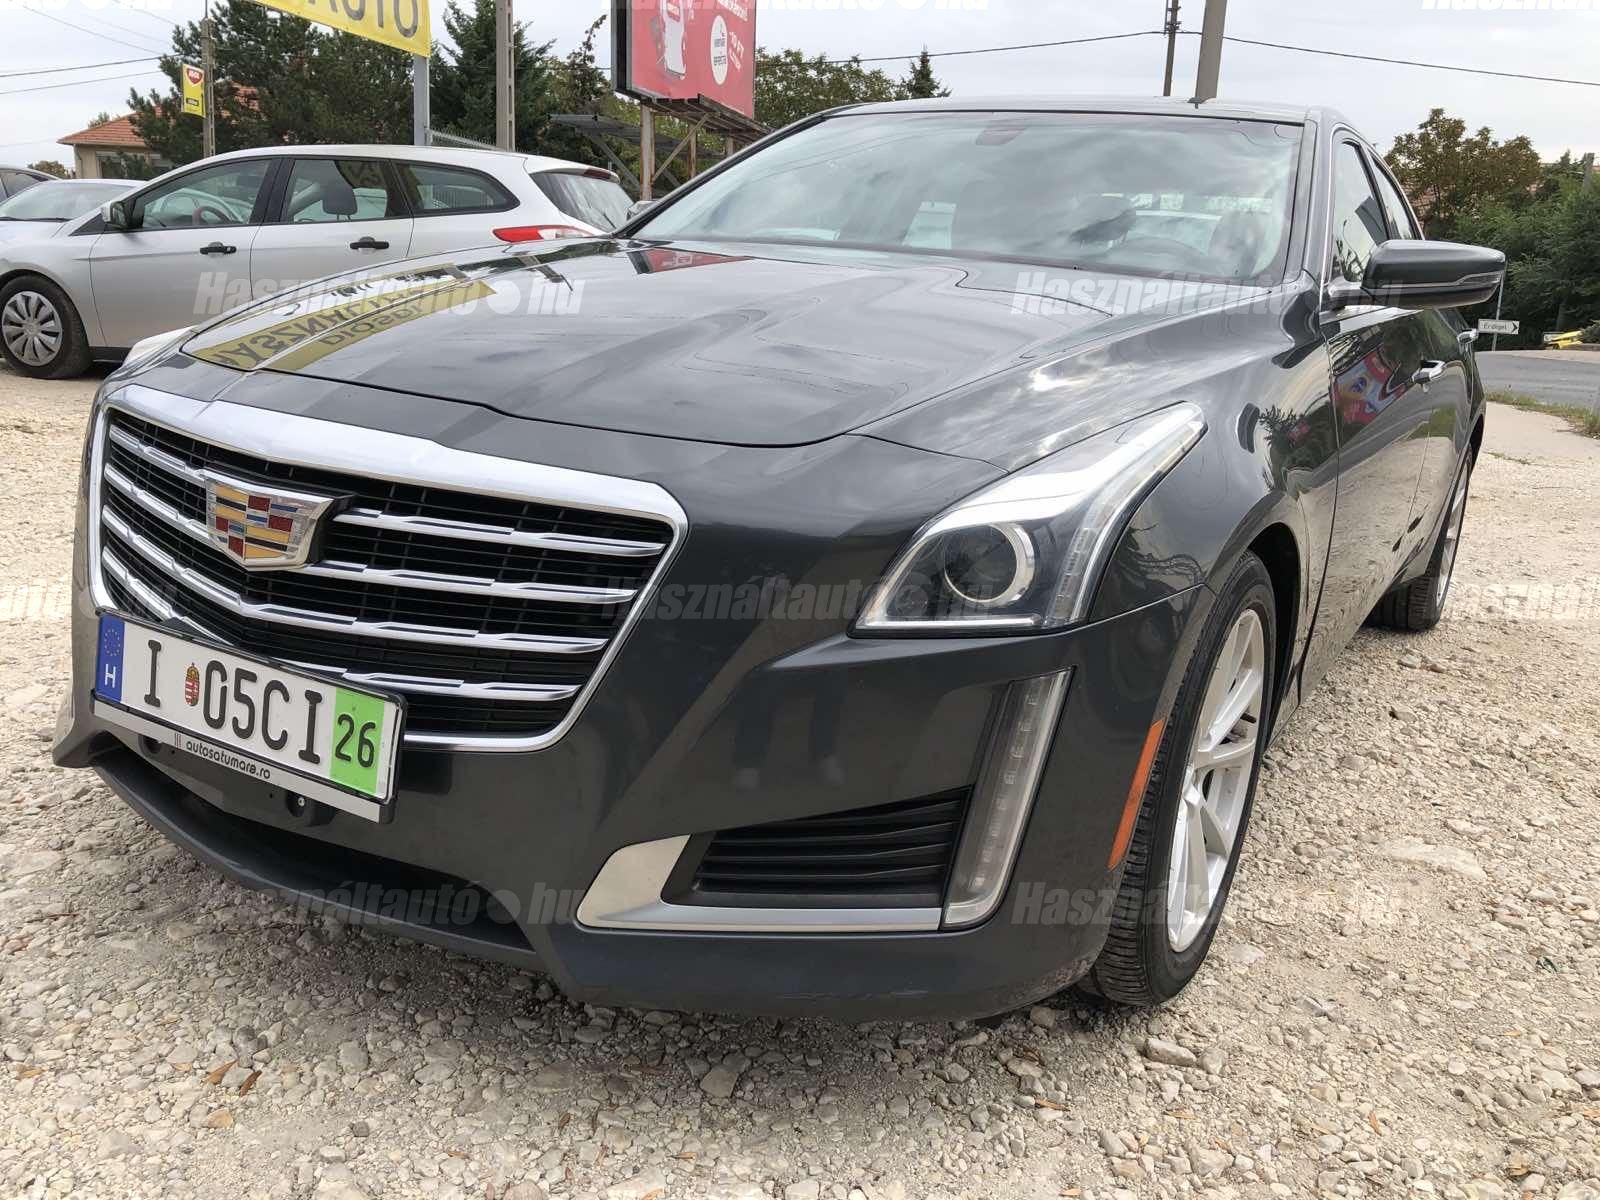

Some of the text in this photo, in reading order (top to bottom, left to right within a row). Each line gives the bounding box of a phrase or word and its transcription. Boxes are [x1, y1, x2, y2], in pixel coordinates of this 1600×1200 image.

[104, 663, 116, 689] H
[185, 739, 271, 780] autosatumare.ro
[334, 713, 376, 769] 26
